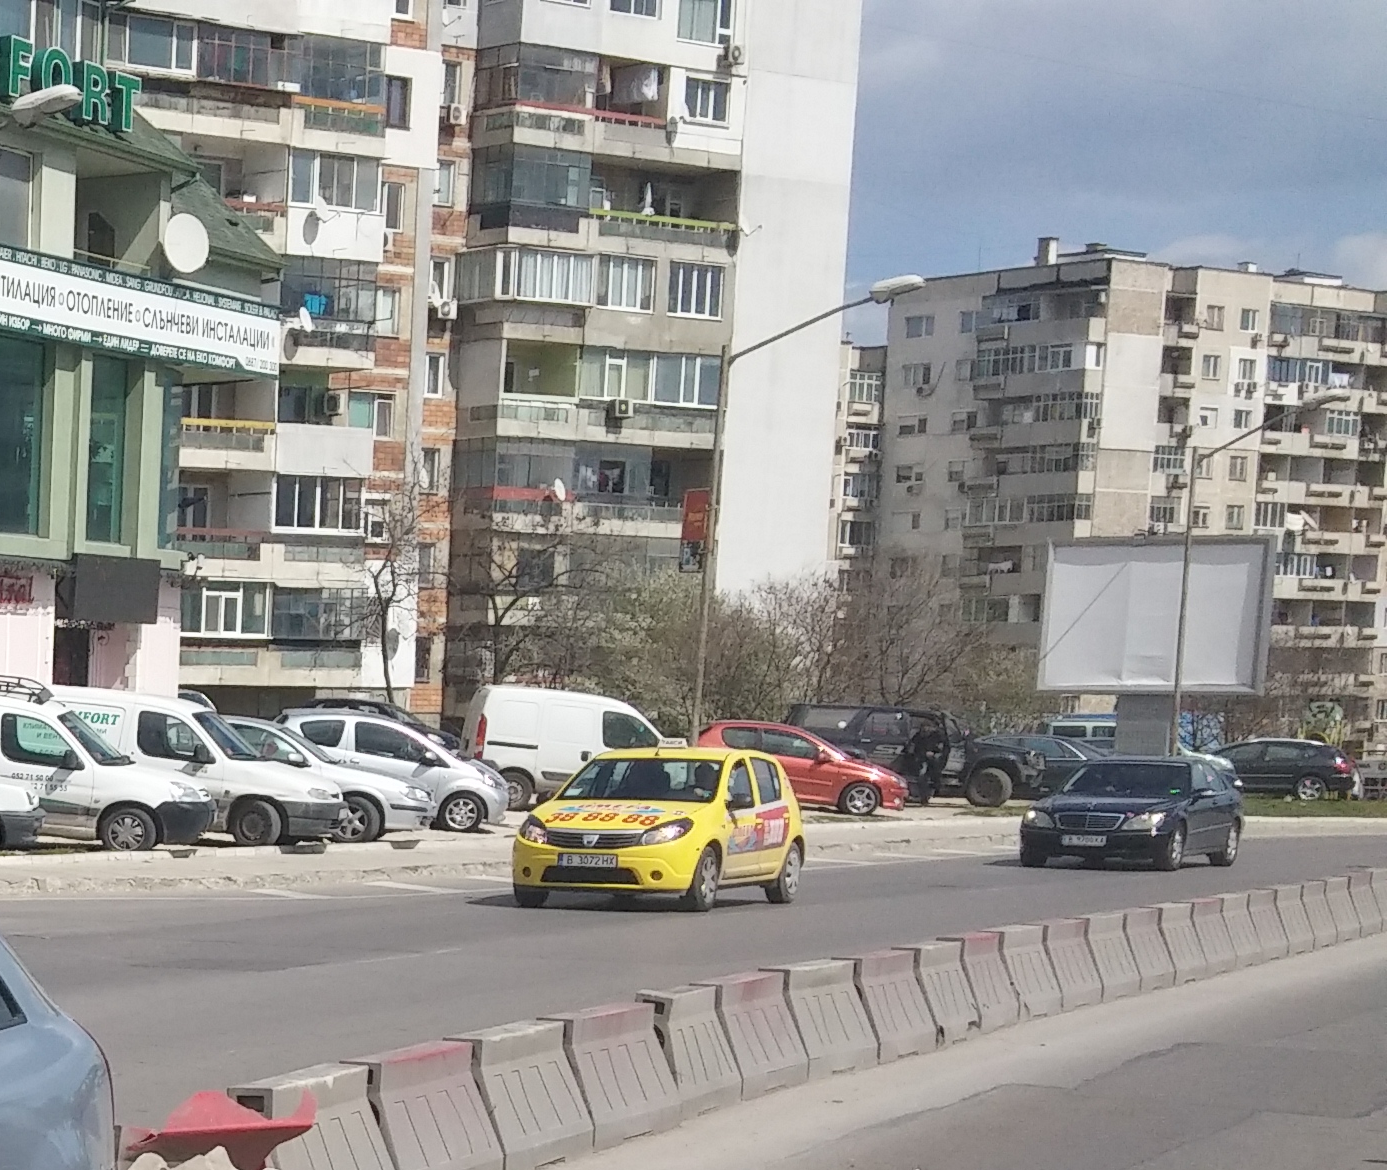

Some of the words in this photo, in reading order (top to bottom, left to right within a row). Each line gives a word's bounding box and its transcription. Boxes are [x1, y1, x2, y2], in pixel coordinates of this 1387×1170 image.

[9, 315, 31, 331] ИЗБОР
[42, 323, 67, 340] МНОГО
[66, 289, 133, 323] ОТОПЛЕНИЕ
[142, 307, 199, 337] СЛЪНЧЕВИ
[202, 317, 270, 351] ИНСТАЛАЦИИ
[545, 812, 579, 824] 38
[582, 812, 619, 822] 88
[622, 814, 660, 826] 88
[566, 856, 573, 865] B
[578, 856, 600, 865] 3072
[602, 856, 615, 865] HX
